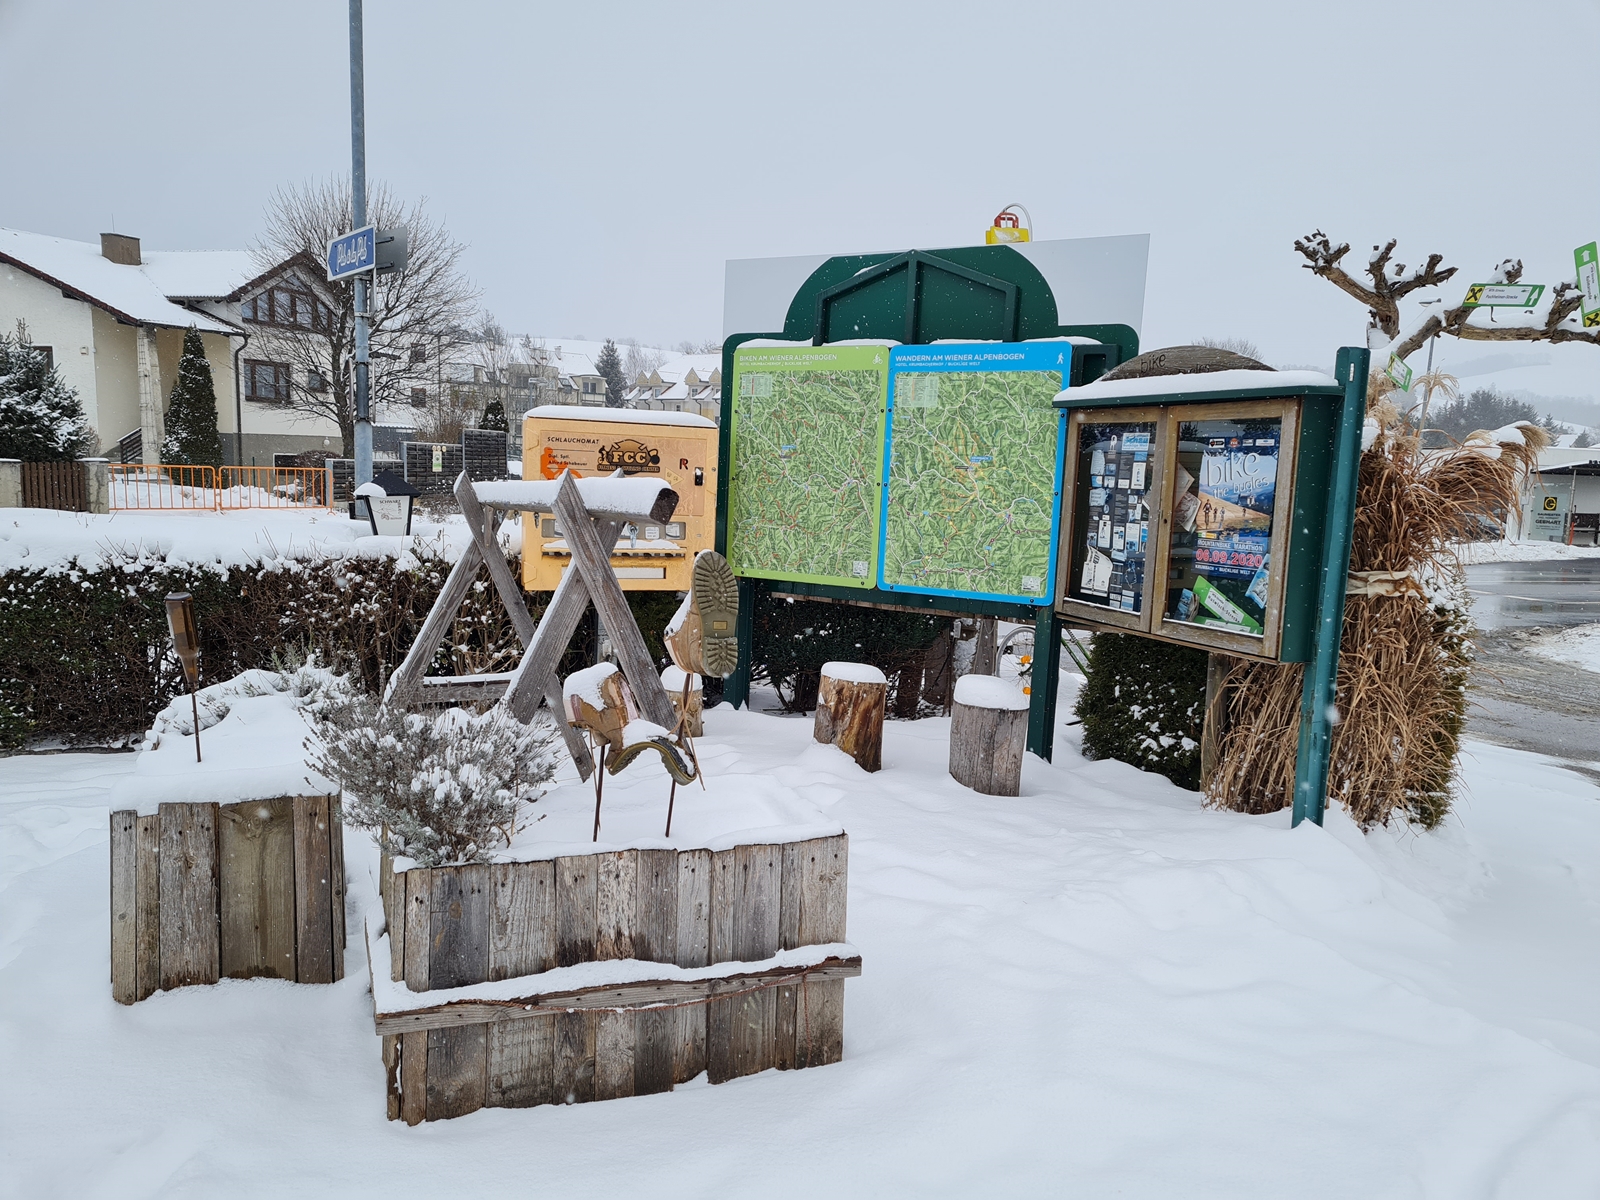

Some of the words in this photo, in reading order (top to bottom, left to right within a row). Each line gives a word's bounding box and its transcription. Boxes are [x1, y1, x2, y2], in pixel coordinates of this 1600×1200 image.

[1140, 353, 1167, 374] bike
[547, 436, 599, 445] SCHLAUCHOMAT
[612, 451, 647, 464] FCC
[1207, 452, 1260, 487] bike
[1213, 487, 1229, 499] the
[1233, 477, 1270, 494] bugles
[1197, 540, 1231, 549] MOUNTAINBIKE
[1233, 543, 1263, 552] MARATHON
[1195, 548, 1264, 568] 06.09.2020
